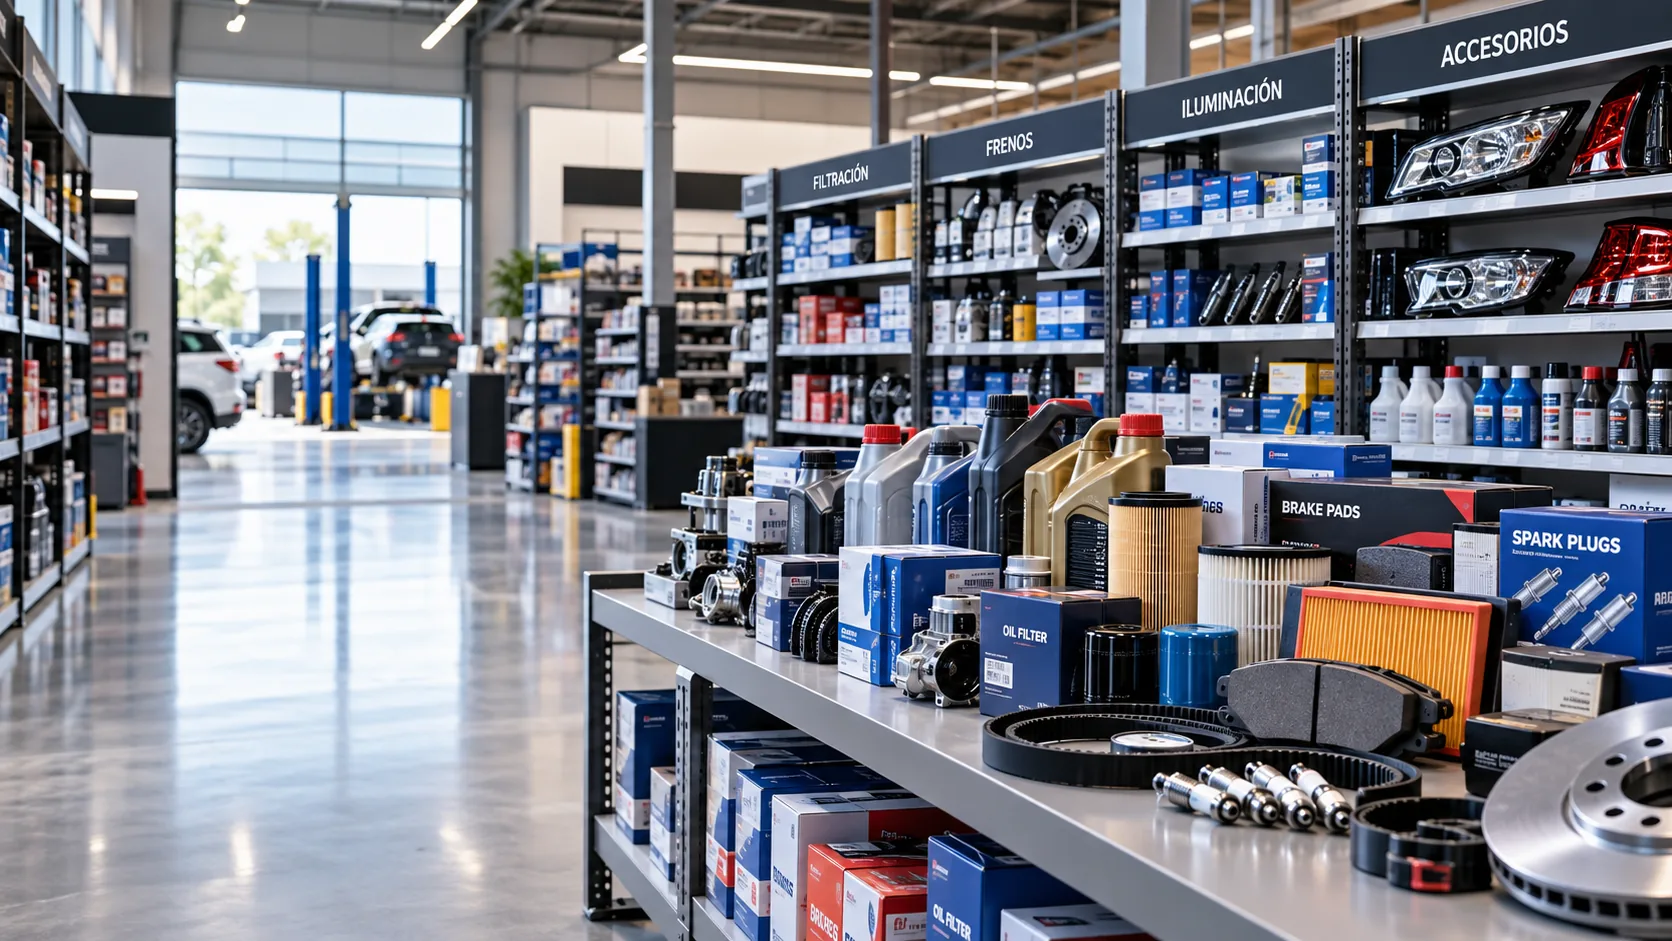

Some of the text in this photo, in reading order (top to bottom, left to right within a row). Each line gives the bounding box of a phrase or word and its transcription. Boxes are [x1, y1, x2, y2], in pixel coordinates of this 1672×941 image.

[1440, 19, 1569, 68] ACCESORIOS
[1181, 77, 1283, 119] ILUMINACIÓN
[986, 131, 1034, 157] FRENOS
[813, 163, 869, 190] FILTRACIÓN
[1281, 500, 1361, 519] BRAKE PADS
[1512, 529, 1564, 549] SPARK
[1567, 533, 1621, 554] PLUGS
[1002, 624, 1048, 644] OIL FILTER
[932, 903, 945, 925] OIL
[945, 911, 972, 941] FILTER
